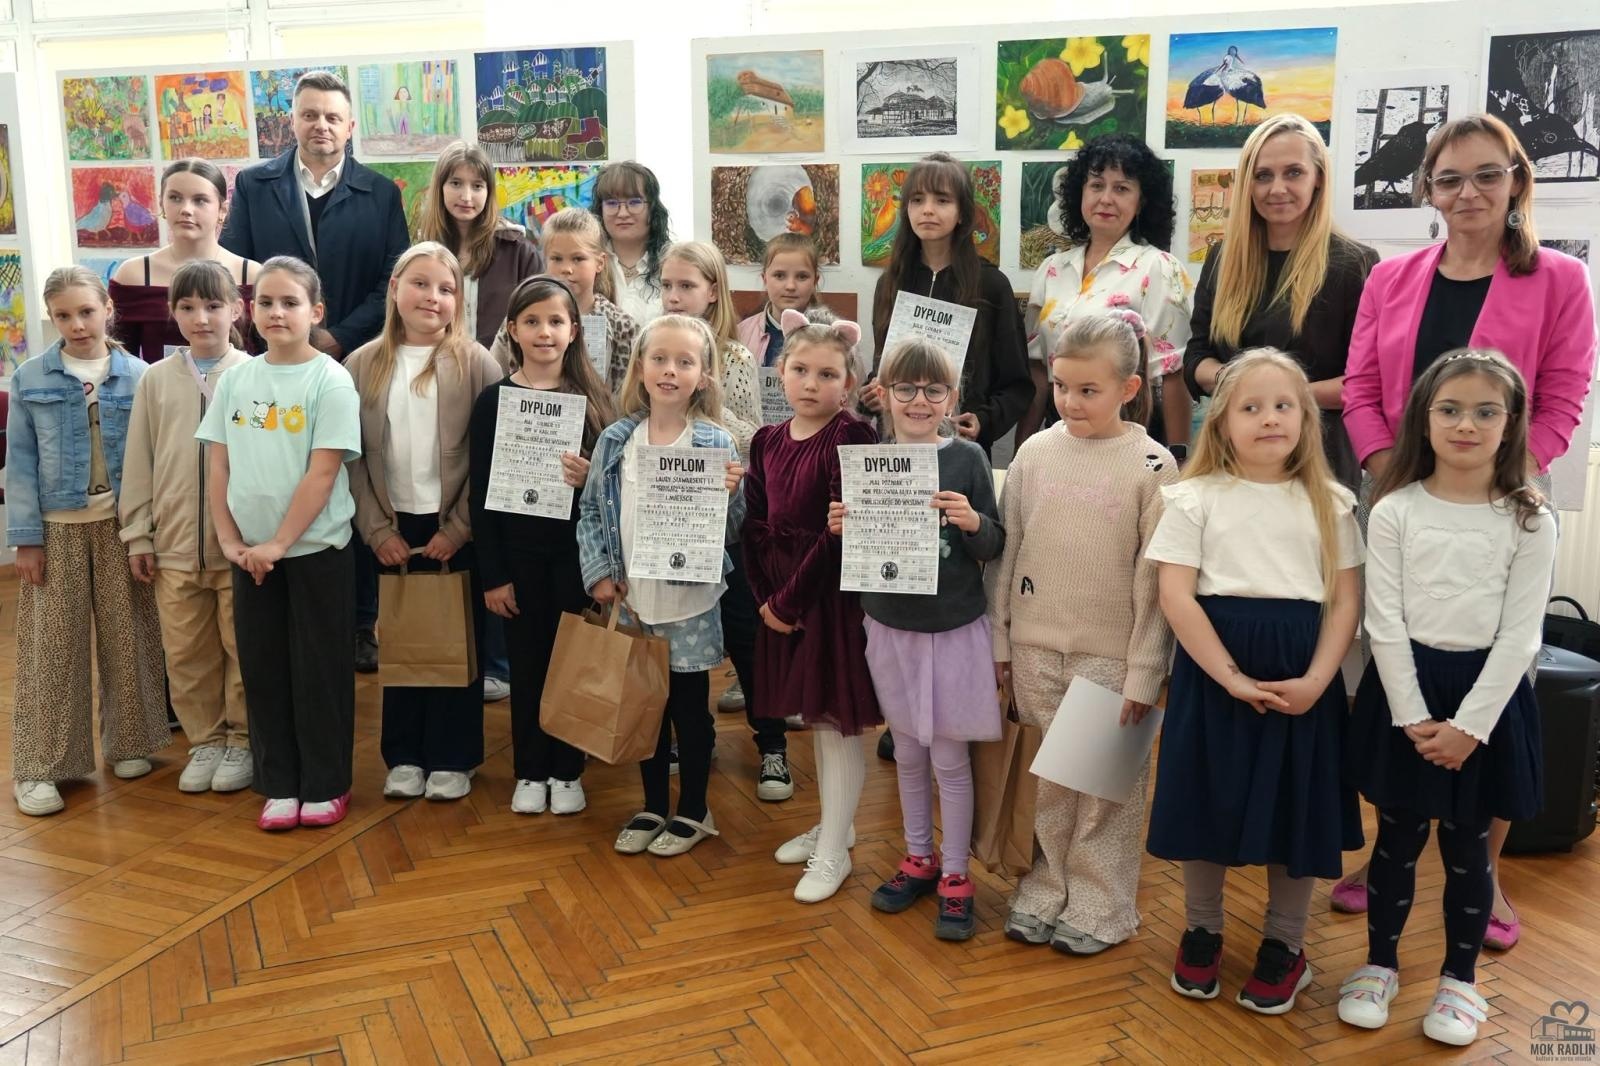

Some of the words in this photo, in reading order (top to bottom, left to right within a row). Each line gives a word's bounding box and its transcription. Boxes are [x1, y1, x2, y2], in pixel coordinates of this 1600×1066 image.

[913, 305, 953, 326] DYPLOM
[520, 399, 562, 418] DYPLOM
[659, 457, 705, 473] DYPLOM
[864, 457, 911, 473] DYPLOM
